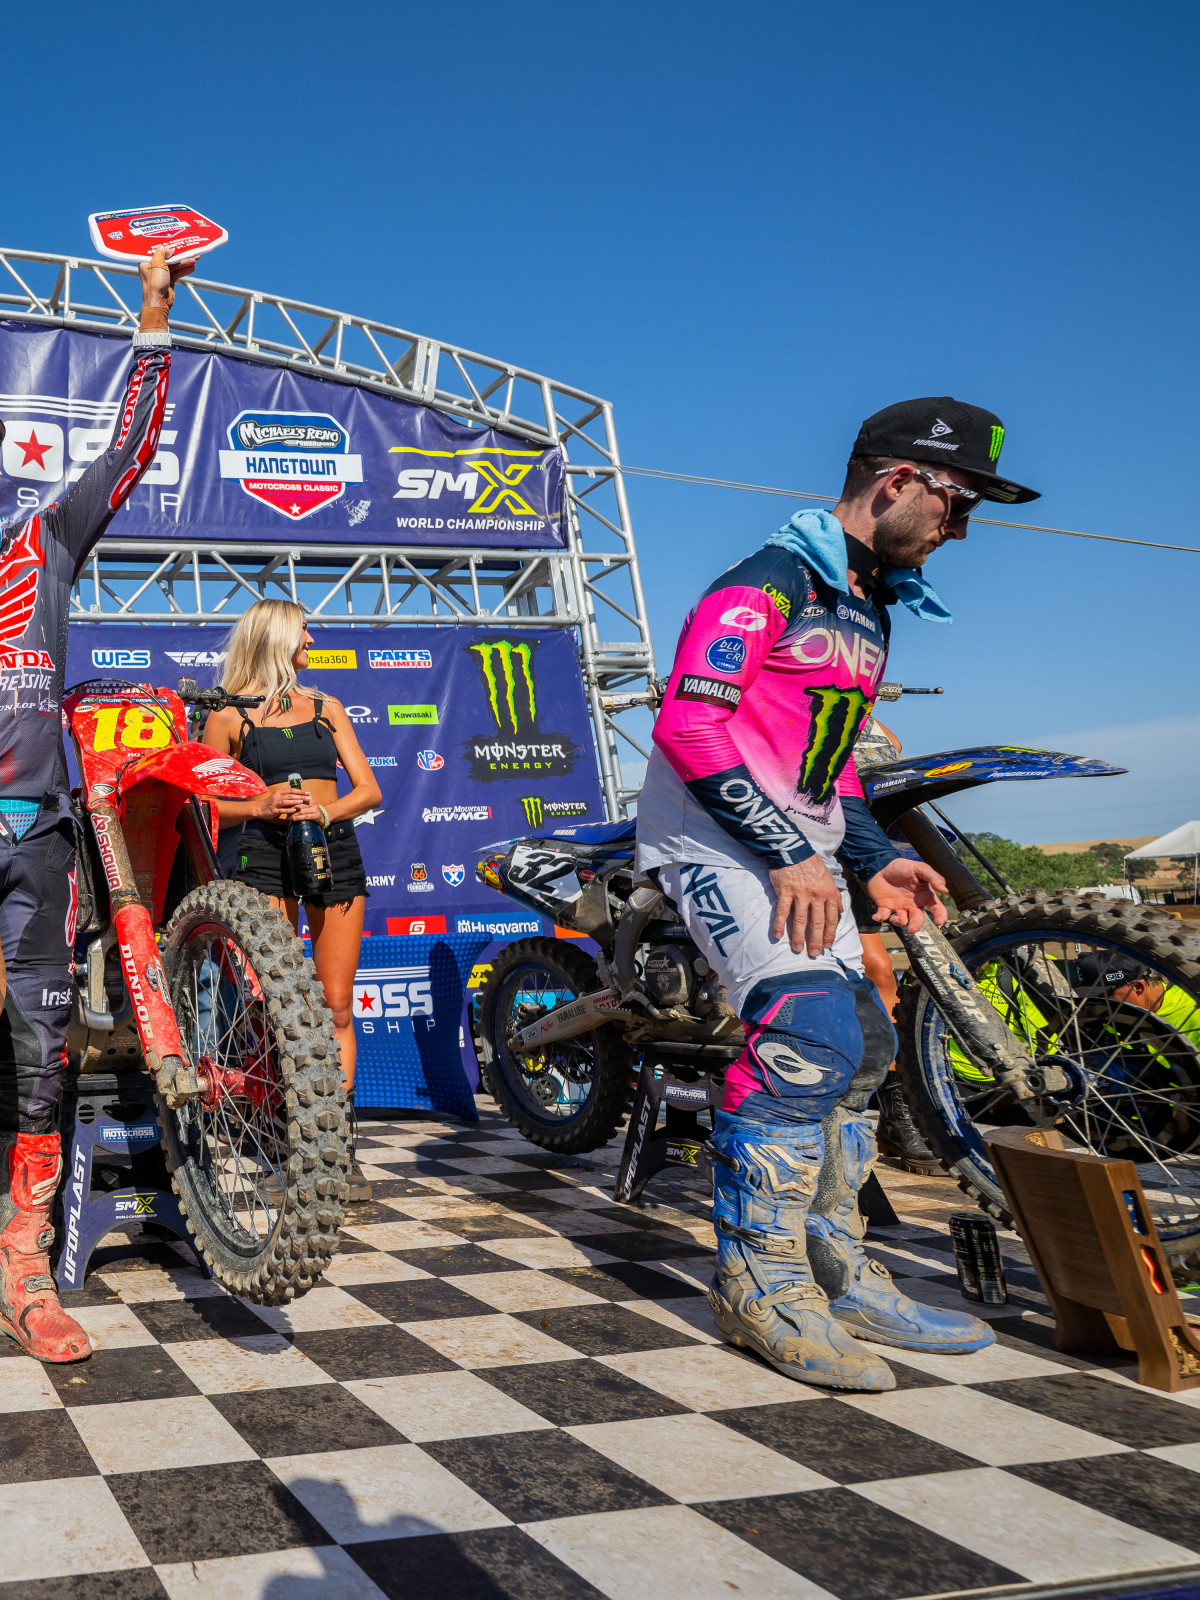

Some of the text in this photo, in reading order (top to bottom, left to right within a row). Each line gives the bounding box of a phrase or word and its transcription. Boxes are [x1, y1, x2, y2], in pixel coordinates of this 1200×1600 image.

[238, 420, 339, 448] MICHAEL'S RENO
[912, 437, 961, 452] PROGRESSIVE
[246, 456, 337, 476] HANGTOWN
[248, 481, 339, 492] MOTOCROSS CLASSIC
[392, 460, 538, 515] SMX
[396, 516, 547, 532] WORLD CHAMPIONSHIP
[92, 650, 151, 668] WPS
[308, 654, 348, 664] nsta360
[369, 650, 431, 661] PARTS
[370, 660, 432, 668] UNLIMITED
[352, 716, 380, 724] KLEY
[393, 711, 433, 720] Kawasaki
[91, 706, 174, 753] 18
[473, 742, 567, 761] MONSTER
[367, 756, 397, 767] ZUKI
[489, 761, 553, 770] ENERGY
[543, 802, 587, 811] MONSTER
[719, 777, 806, 865] O'NEAL
[97, 831, 123, 892] SHOWA
[365, 874, 396, 887] ARMY
[413, 869, 426, 878] 66
[449, 872, 460, 882] X
[508, 852, 577, 896] 32
[679, 864, 741, 958] NEAL
[470, 919, 540, 937] Husqvarna
[919, 956, 949, 997] BRAKING
[120, 943, 154, 1039] DUNLOP
[556, 1003, 588, 1023] YAMALUBE
[665, 1087, 707, 1099] MOTOCROSS
[102, 1129, 155, 1139] MOTOCROSS
[623, 1094, 652, 1201] UFOPLAST
[666, 1147, 697, 1163] SMX
[114, 1196, 156, 1214] SMX
[63, 1144, 87, 1285] UFOPLAST
